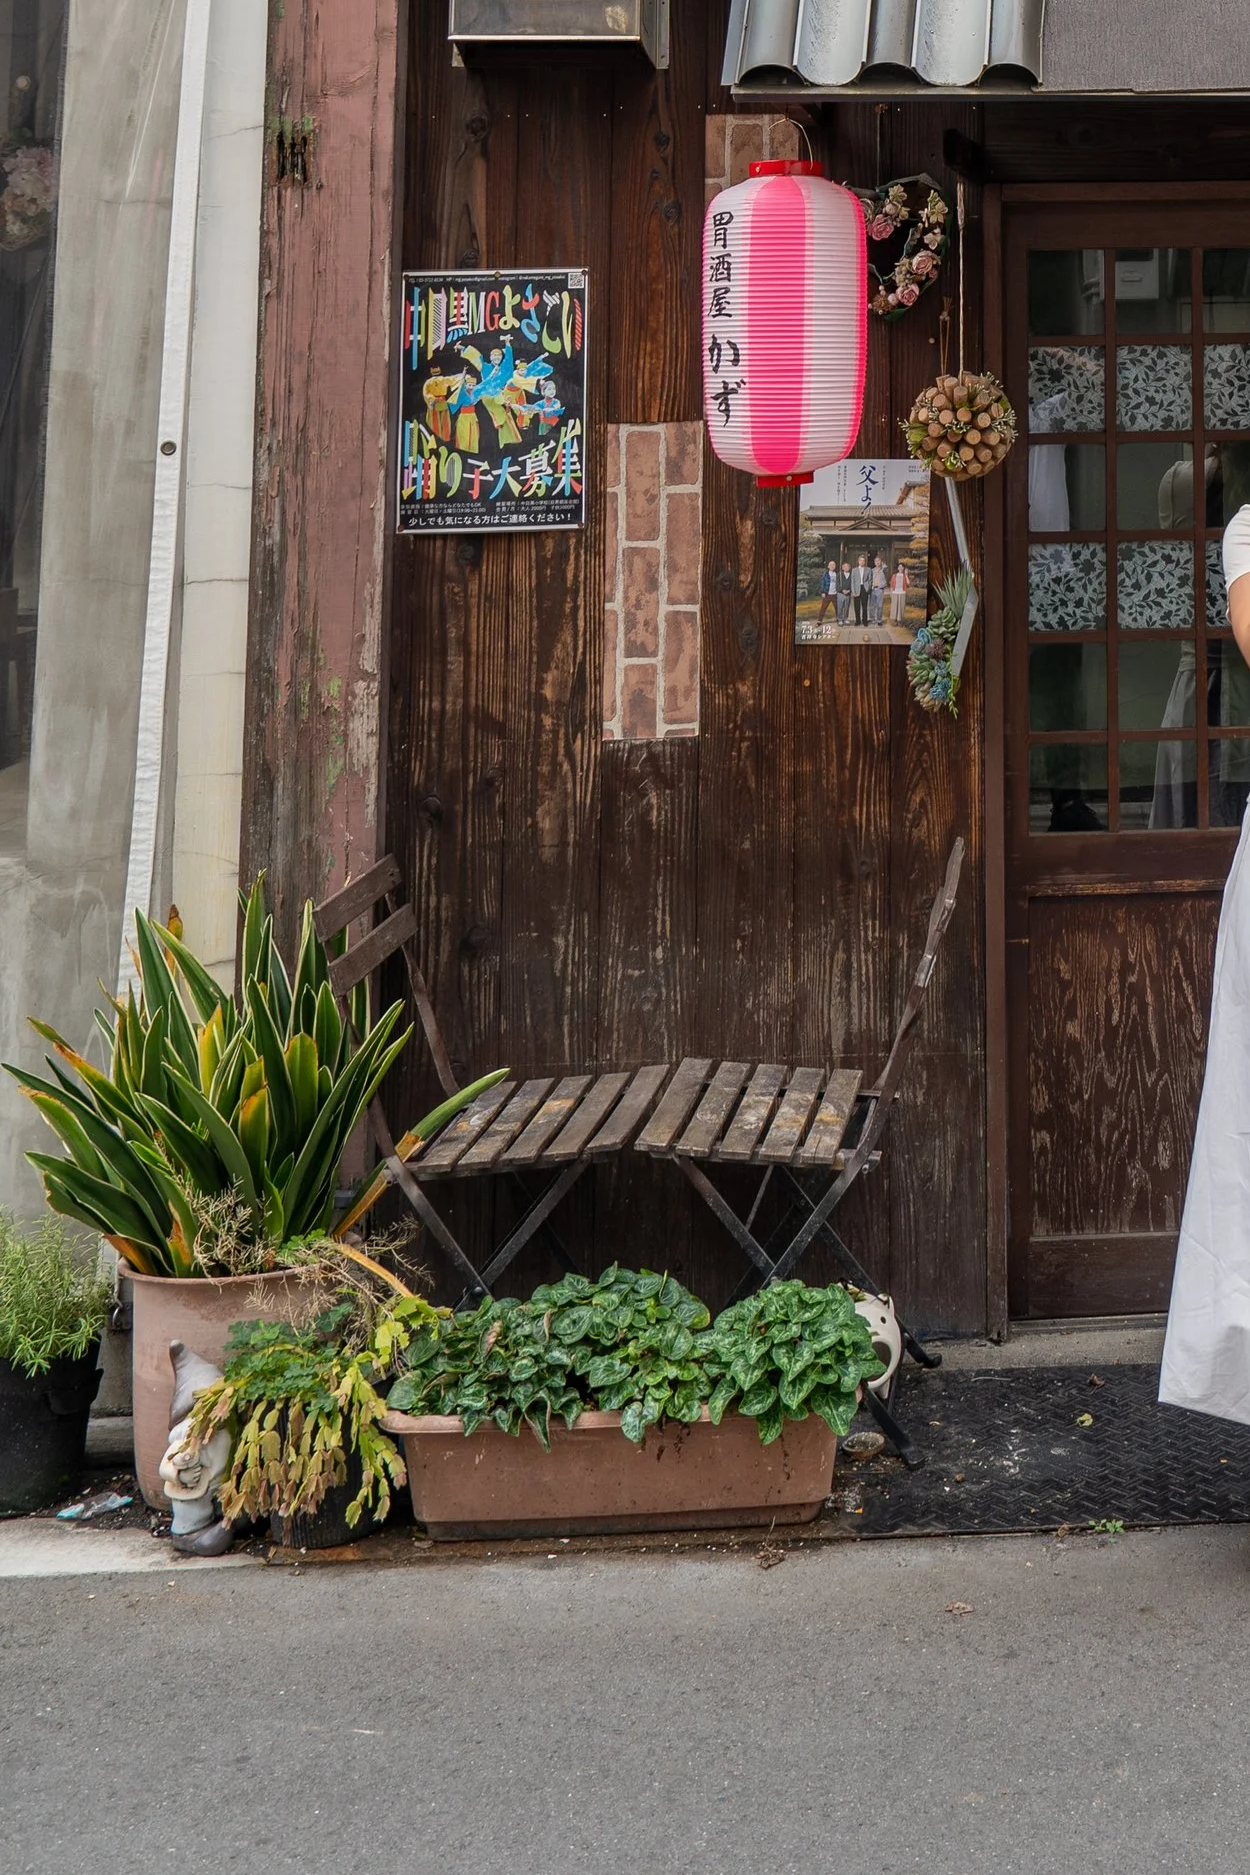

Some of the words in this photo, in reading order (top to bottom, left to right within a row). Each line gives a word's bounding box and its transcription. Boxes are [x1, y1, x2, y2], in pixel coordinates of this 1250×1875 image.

[404, 283, 583, 371] 中目黒MGよさこい
[401, 417, 583, 501] 踊り子大募集
